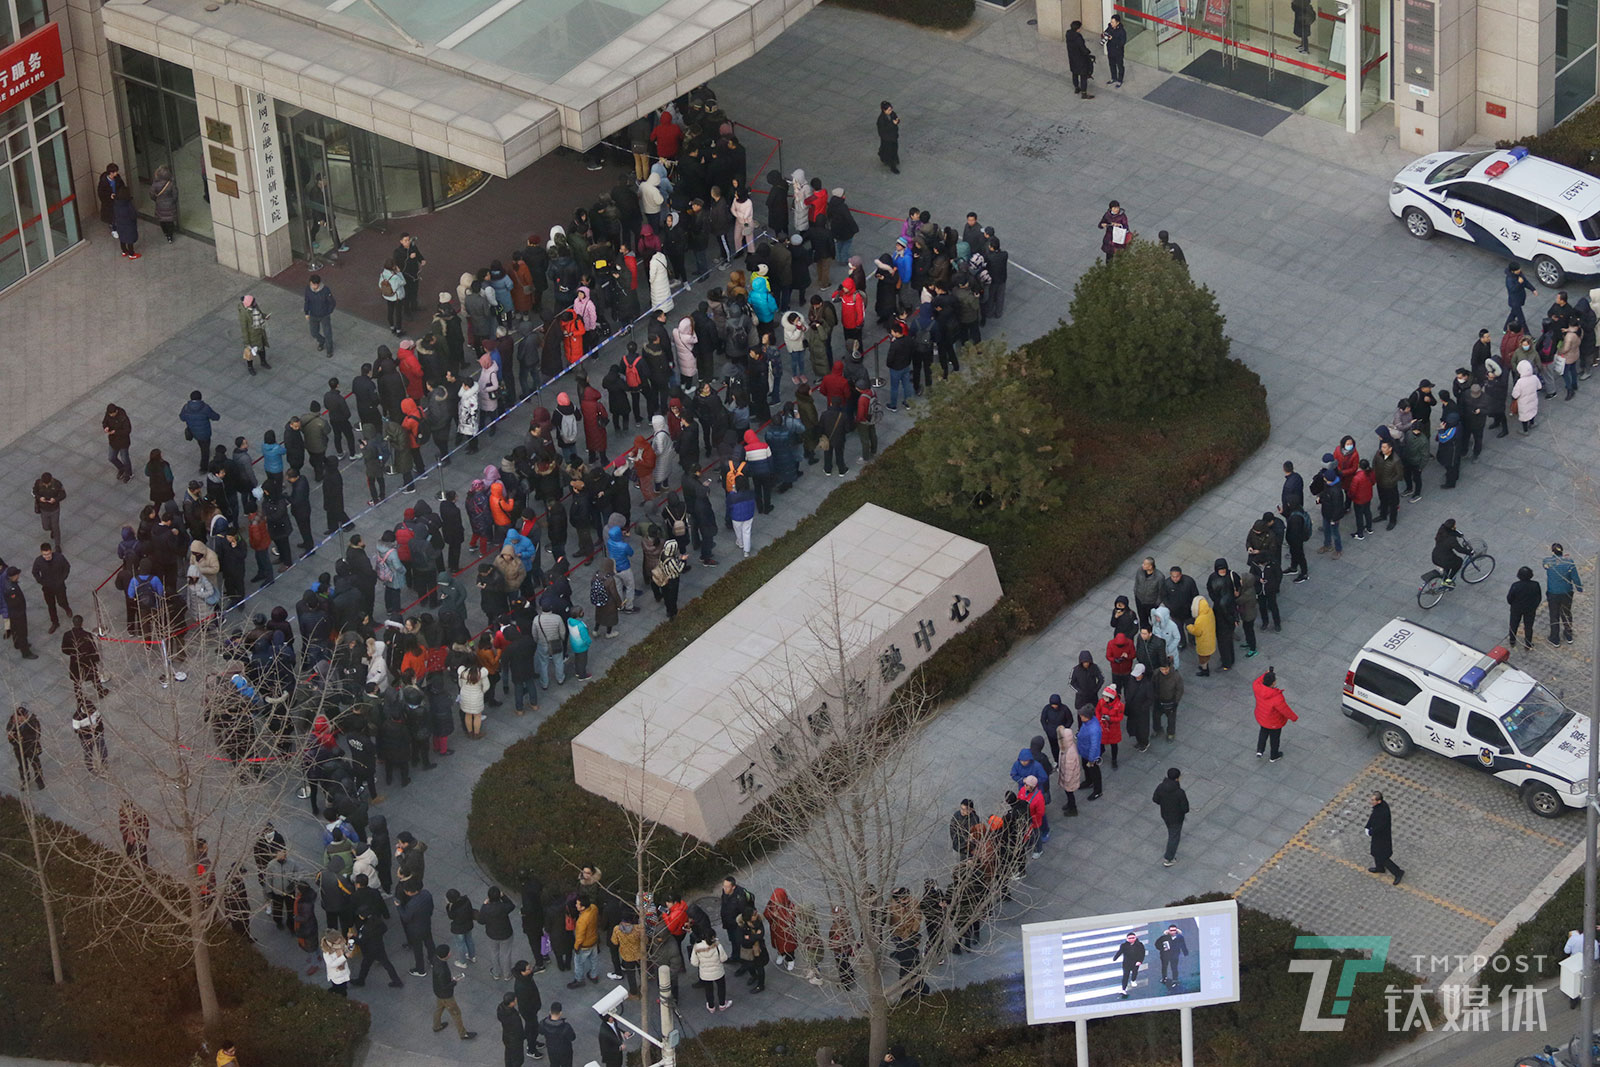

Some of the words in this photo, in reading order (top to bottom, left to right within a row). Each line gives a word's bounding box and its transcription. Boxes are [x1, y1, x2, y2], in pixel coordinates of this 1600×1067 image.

[9, 71, 45, 97] BANKING
[1563, 181, 1589, 201] A4437
[1500, 227, 1521, 242] 公安
[1383, 629, 1411, 650] 5550
[1430, 731, 1456, 750] 公安
[1557, 730, 1588, 754] 警察
